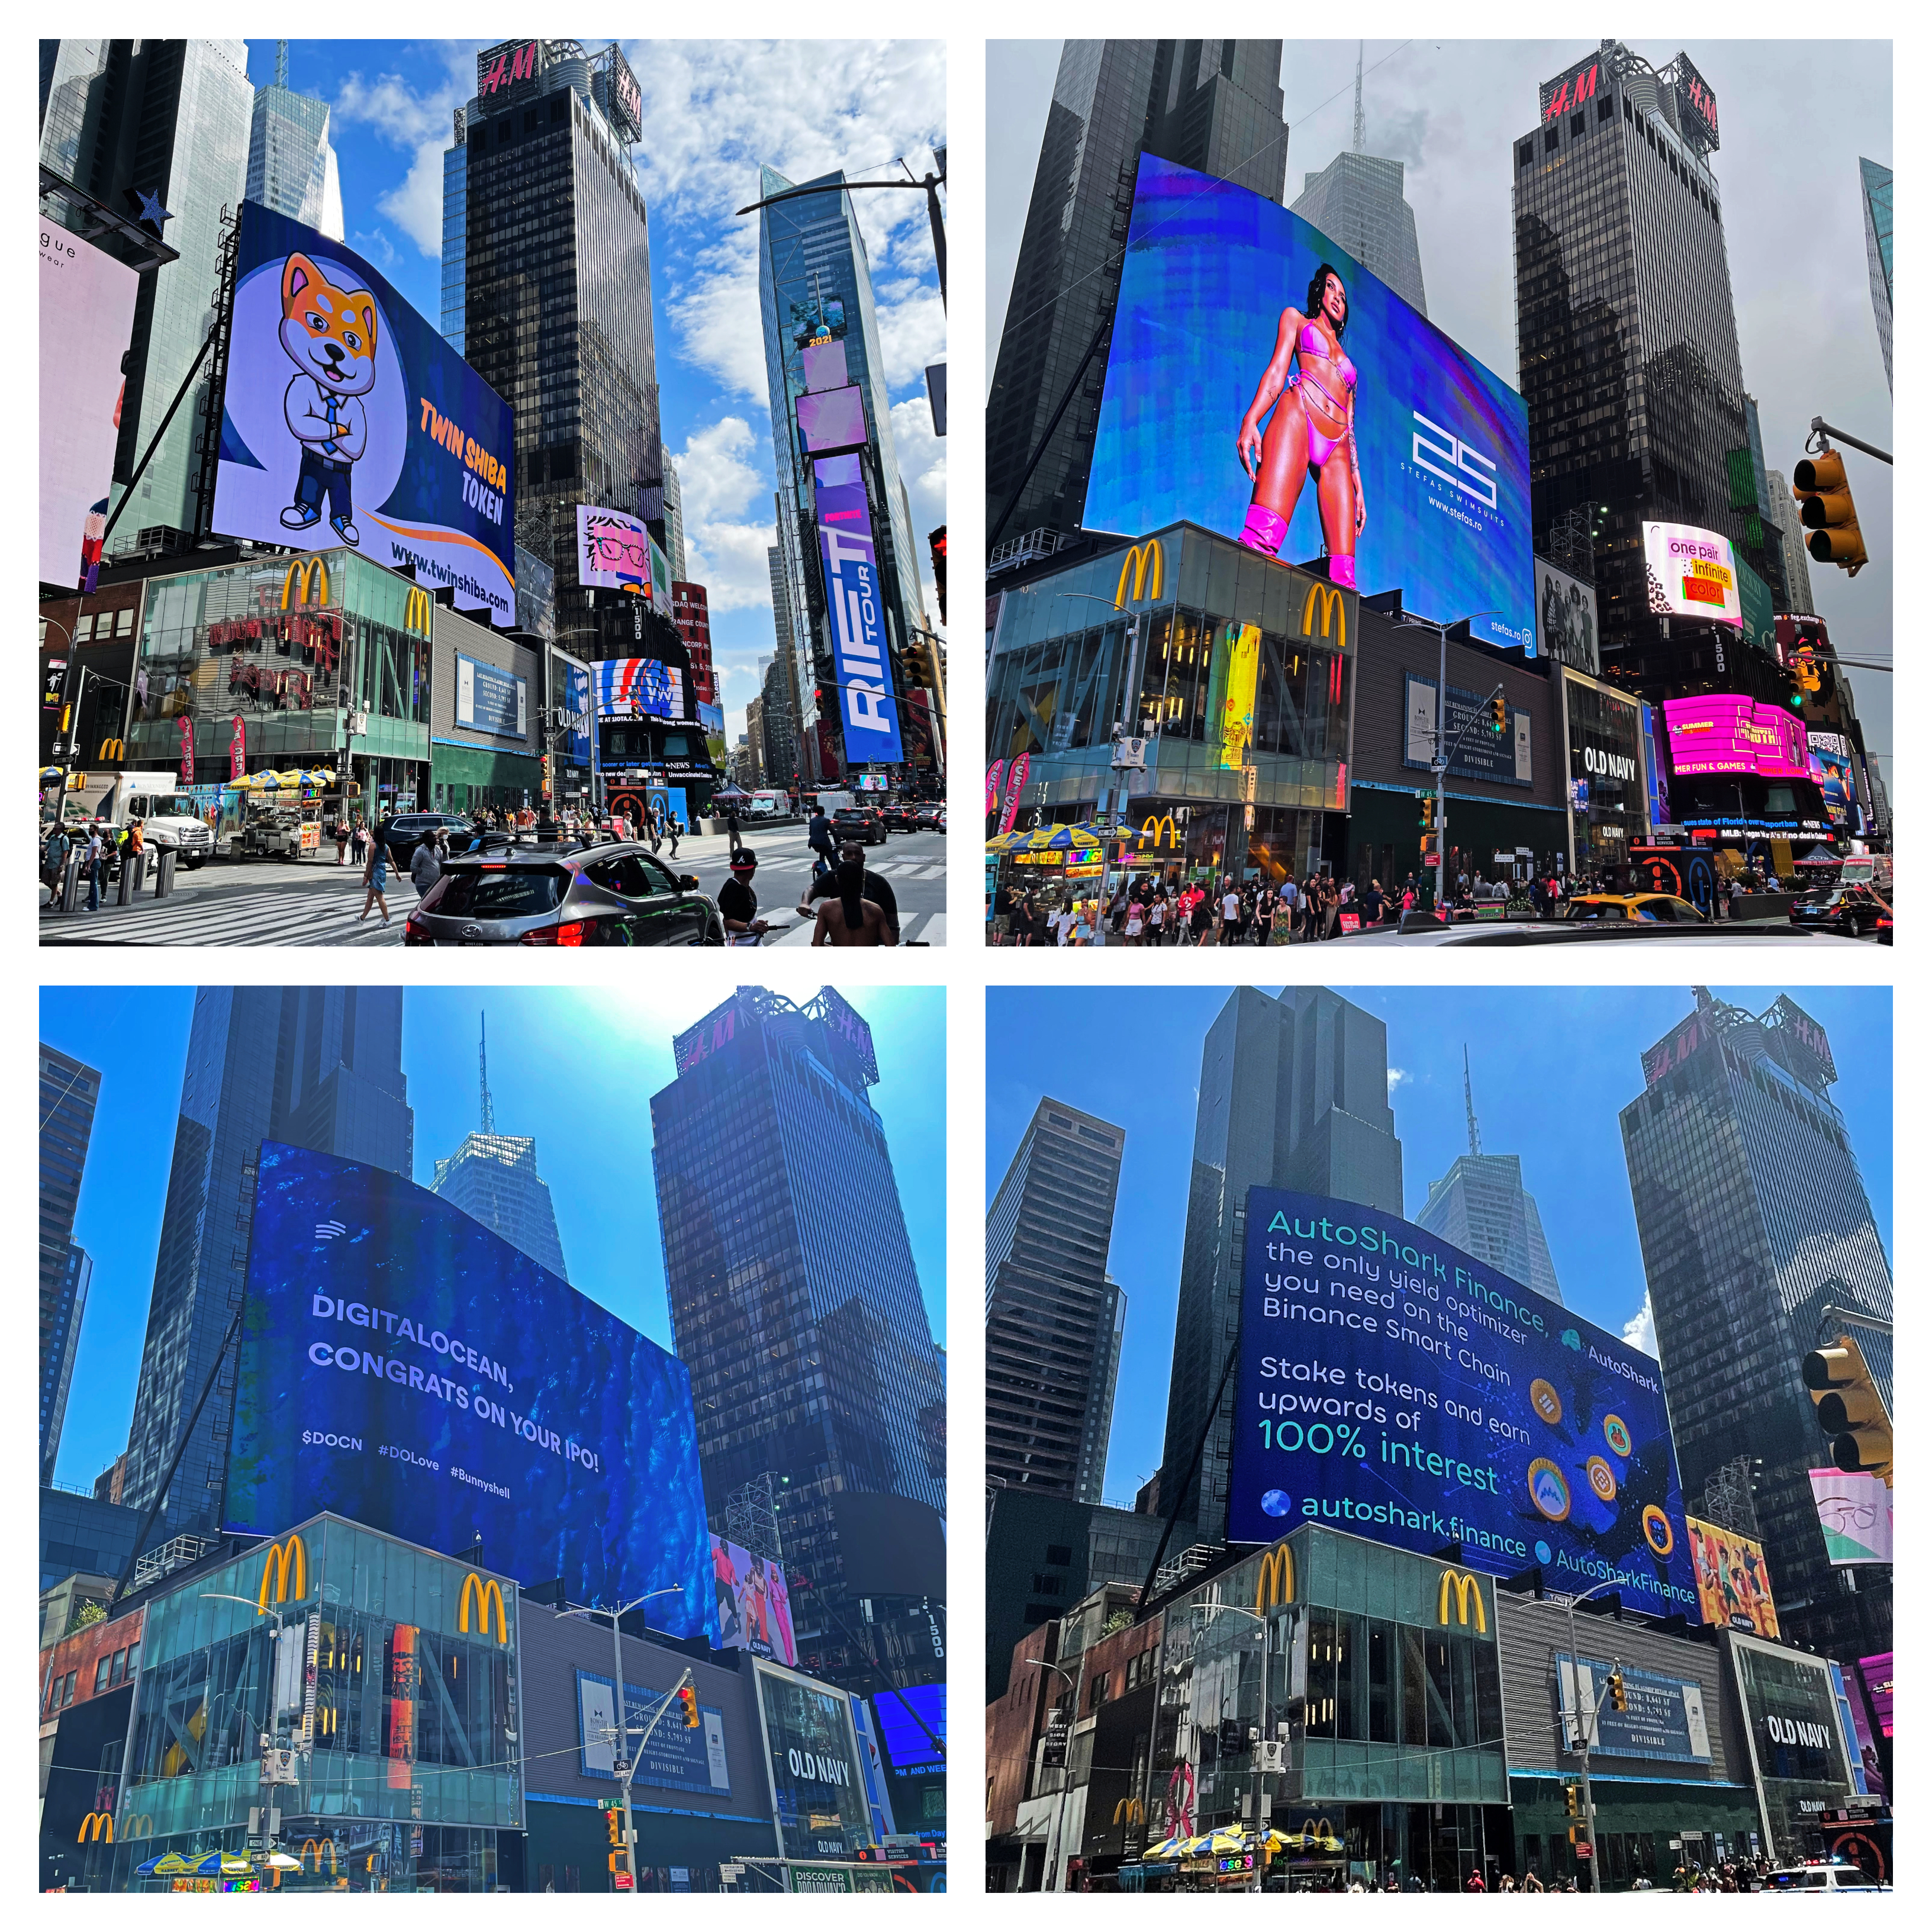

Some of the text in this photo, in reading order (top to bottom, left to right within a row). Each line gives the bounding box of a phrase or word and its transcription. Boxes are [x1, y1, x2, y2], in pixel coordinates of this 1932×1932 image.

[482, 42, 536, 96] H&M
[618, 67, 642, 124] H&M
[1545, 64, 1598, 122] H&M
[1688, 76, 1716, 131] H&M
[39, 250, 64, 268] wear
[809, 334, 832, 347] 2021
[421, 397, 506, 495] TWIN SHIBA
[462, 471, 503, 526] TOKEN
[1400, 462, 1505, 526] STEFAS SWIMSUITS
[1428, 495, 1482, 531] www.stefas.ro
[1670, 542, 1718, 561] one pair
[391, 541, 508, 613] www.twinshiba.com
[654, 564, 665, 585] pair
[1694, 561, 1728, 582] infinite
[858, 565, 878, 640] TOUR
[1690, 581, 1720, 598] color
[827, 532, 891, 733] RIFT
[1491, 622, 1521, 640] stefas.ro
[1791, 613, 1820, 623] feg.exchange
[1715, 634, 1725, 672] 1500
[482, 681, 498, 691] GROUND:
[482, 690, 498, 700] SECOND:
[489, 715, 505, 724] DIVISIBLE
[558, 706, 588, 733] OLD NAVY
[1682, 722, 1714, 730] SUMMER
[1481, 729, 1502, 741] 5,793 SF
[1464, 755, 1493, 767] DIVISIBLE
[1585, 746, 1635, 781] OLD NAVY
[1692, 763, 1707, 771] FUN
[1603, 826, 1624, 838] OLD NAVY
[1808, 820, 1820, 829] NEWS
[681, 1009, 735, 1073] H&M
[837, 1007, 872, 1064] H&M
[1267, 1210, 1550, 1338] AutoShark Finance,
[1265, 1272, 1469, 1342] you need on the
[1266, 1242, 1528, 1346] the only yield optimizer
[313, 1294, 514, 1393] DIGITALOCEAN,
[1264, 1297, 1511, 1387] Binance Smart Chain
[1588, 1345, 1659, 1393] AutoShark
[308, 1342, 599, 1473] CONGRATS ON YOUR IPO!
[1258, 1391, 1421, 1432] upwards of
[1260, 1356, 1530, 1445] Stake tokens and earn
[302, 1429, 510, 1499] $DOCN #DOLove #Bunnyshell
[1259, 1419, 1499, 1495] 100% interest
[1302, 1495, 1527, 1559] autoshark.finance
[1557, 1548, 1696, 1605] AutoSharkFinance
[761, 1644, 771, 1654] NAVY
[929, 1615, 945, 1658] 1500
[632, 1702, 655, 1712] REMAINING
[666, 1721, 682, 1731] 8,641
[667, 1733, 691, 1744] 5,793 SF
[1631, 1734, 1666, 1746] DIVISIBLE
[1768, 1716, 1831, 1750] OLD NAVY
[643, 1749, 682, 1762] HEIGHT-STOREFRONT
[666, 1743, 685, 1752] FRONTAGE
[650, 1760, 684, 1775] DIVISIBLE
[788, 1748, 850, 1787] OLD NAVY
[910, 1766, 926, 1775] AND
[1800, 1800, 1825, 1812] OLD NAVY
[817, 1840, 843, 1854] OLD NAVY
[932, 1829, 946, 1838] Day
[796, 1872, 845, 1882] DISCOVER
